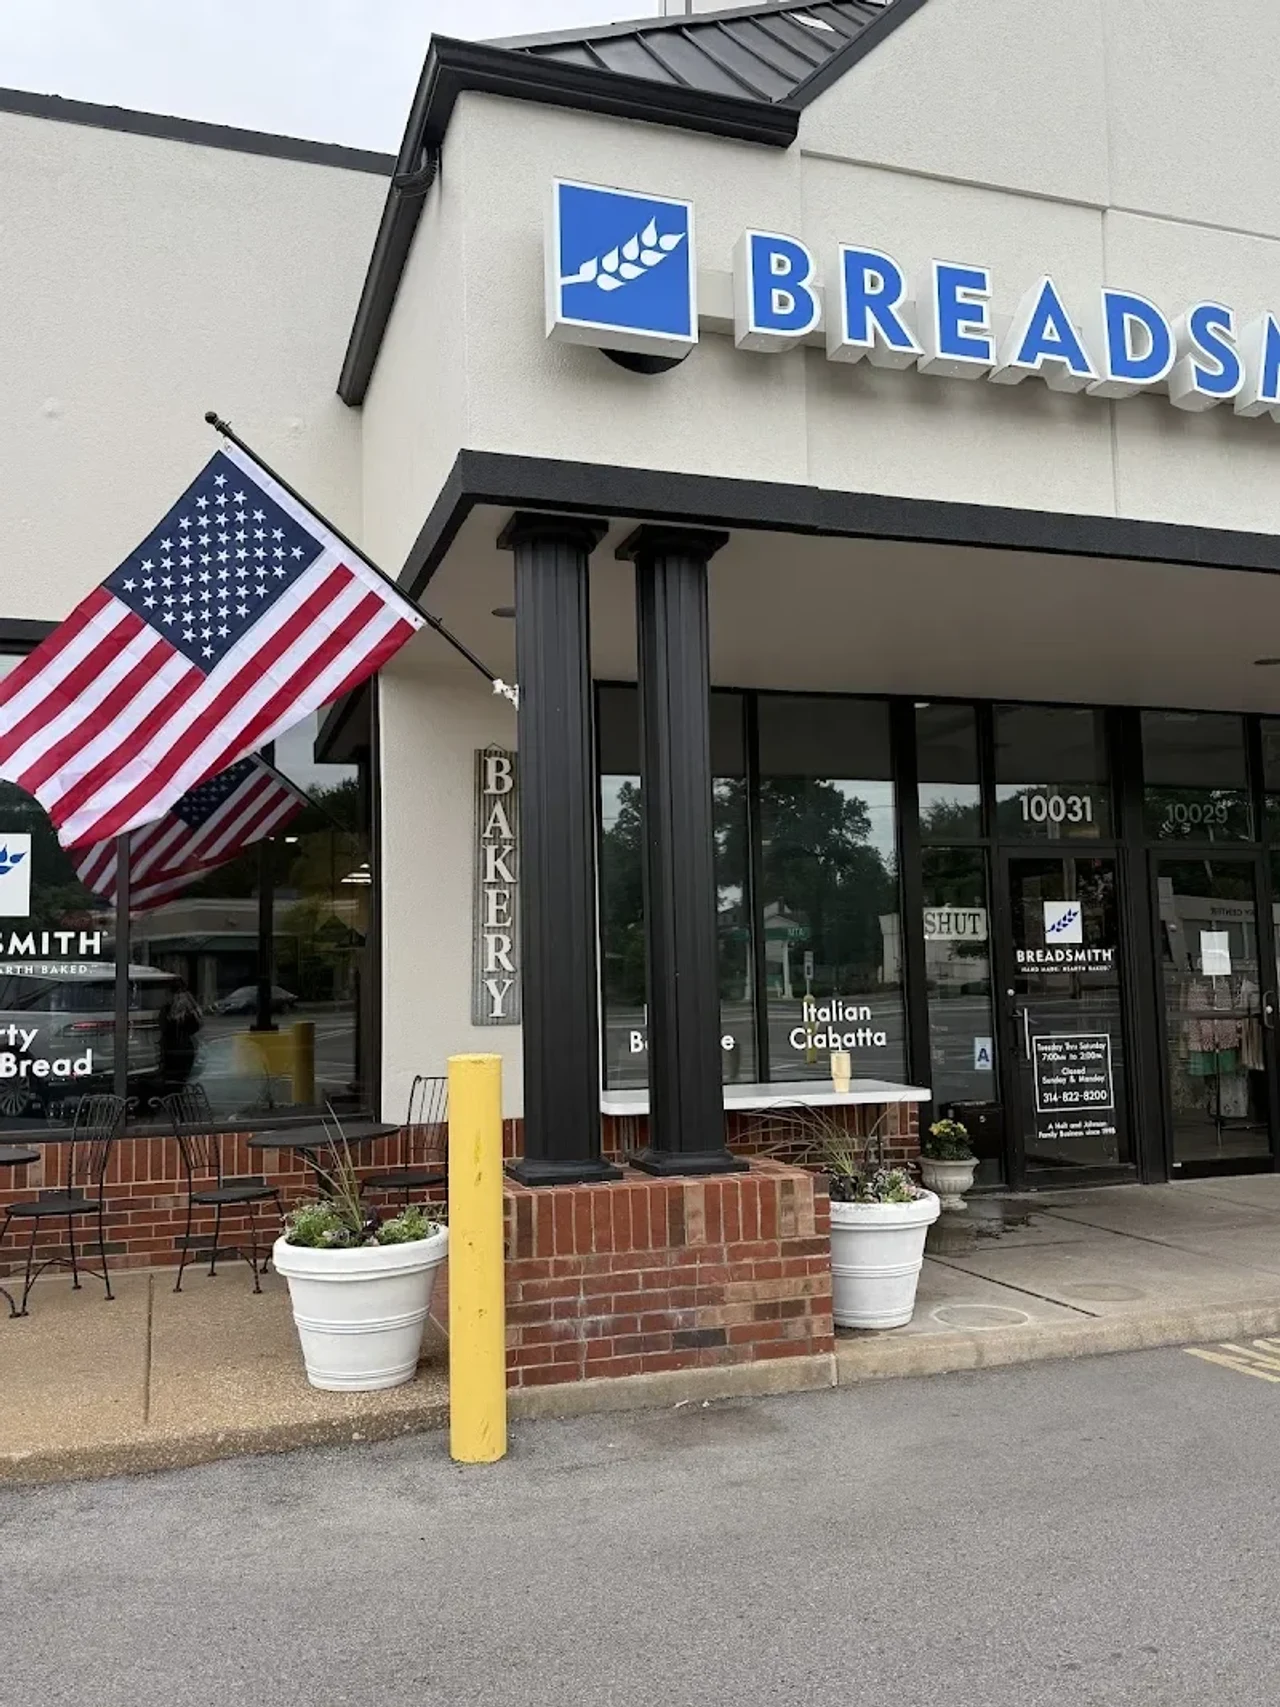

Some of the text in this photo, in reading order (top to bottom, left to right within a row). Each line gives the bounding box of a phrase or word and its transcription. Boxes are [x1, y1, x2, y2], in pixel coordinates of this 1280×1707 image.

[746, 228, 1280, 401] BREADS
[1019, 795, 1093, 822] 10031
[1165, 803, 1228, 824] 10029
[482, 756, 517, 1018] BAKERY
[924, 912, 982, 935] SHUT
[0, 931, 101, 955] MITH
[1016, 948, 1112, 963] BREADSMITH
[803, 1000, 872, 1022] Italian
[789, 1026, 887, 1050] Ciabatta
[0, 1048, 93, 1078] Bread
[976, 1047, 990, 1062] A
[1043, 1089, 1107, 1103] 314-822-8200
